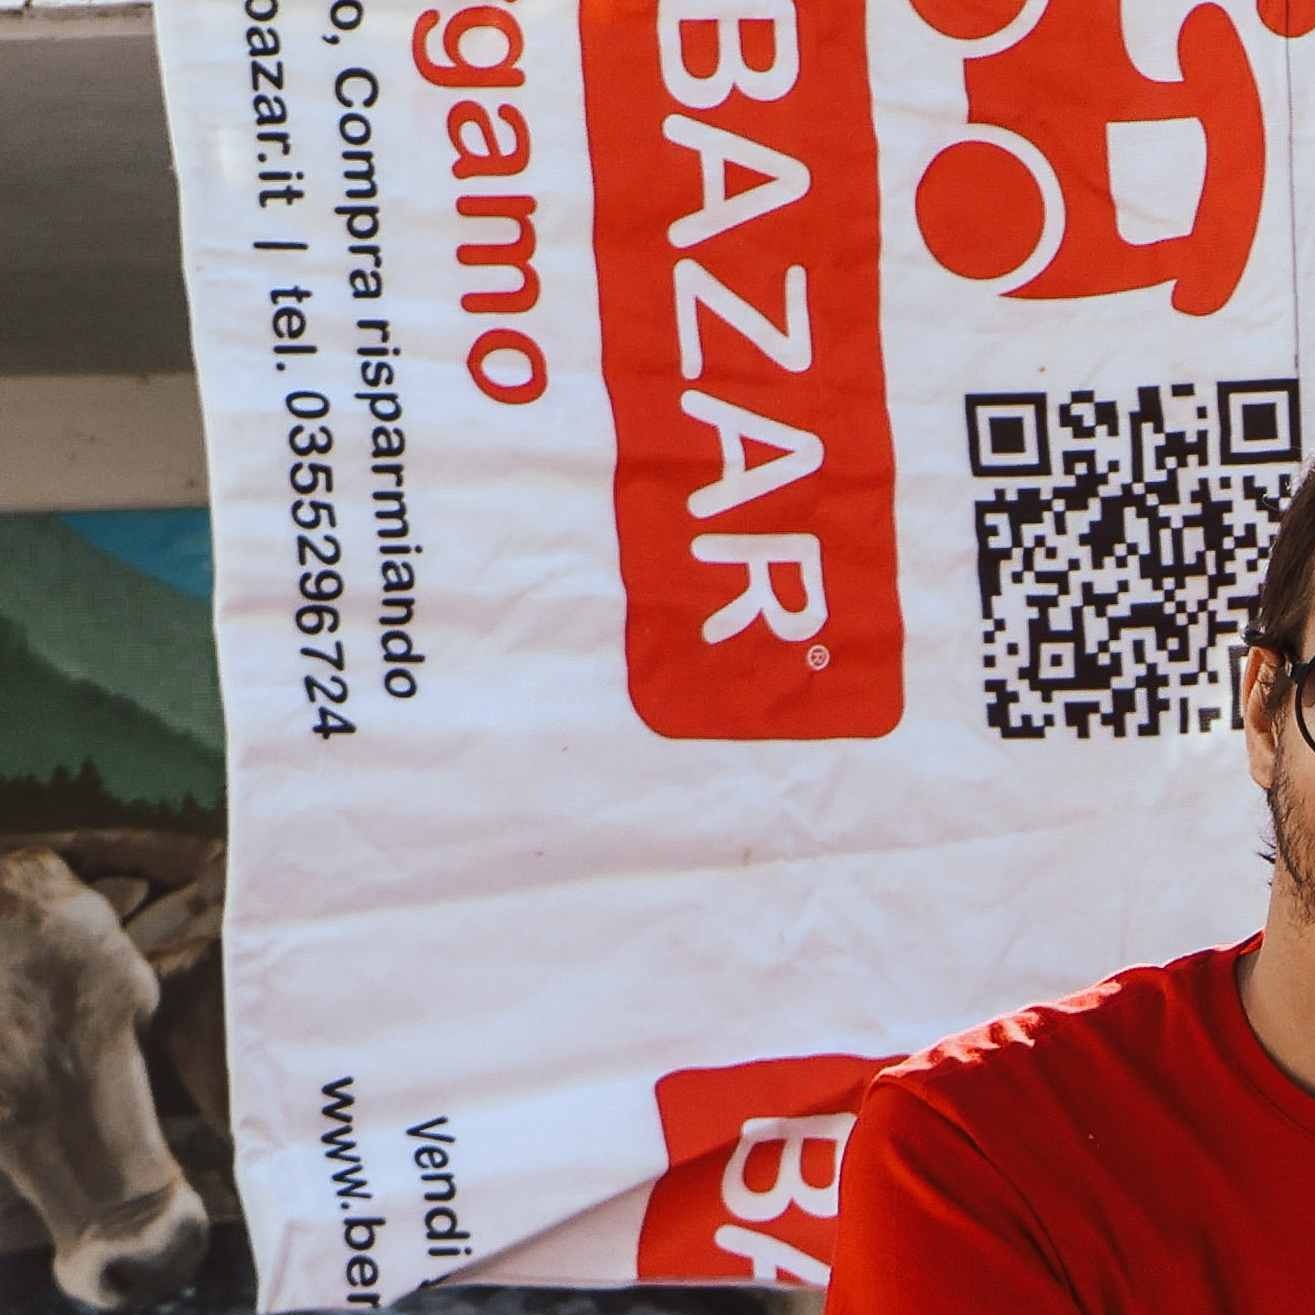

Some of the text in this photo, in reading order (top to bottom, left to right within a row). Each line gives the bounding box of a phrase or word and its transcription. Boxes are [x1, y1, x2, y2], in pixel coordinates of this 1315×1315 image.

[334, 66, 382, 299] Compra
[654, 0, 829, 645] BAZAR
[270, 288, 317, 372] tel.
[286, 390, 357, 741] 0355296724
[353, 318, 425, 699] risparmiando
[406, 1116, 473, 1257] Vendi
